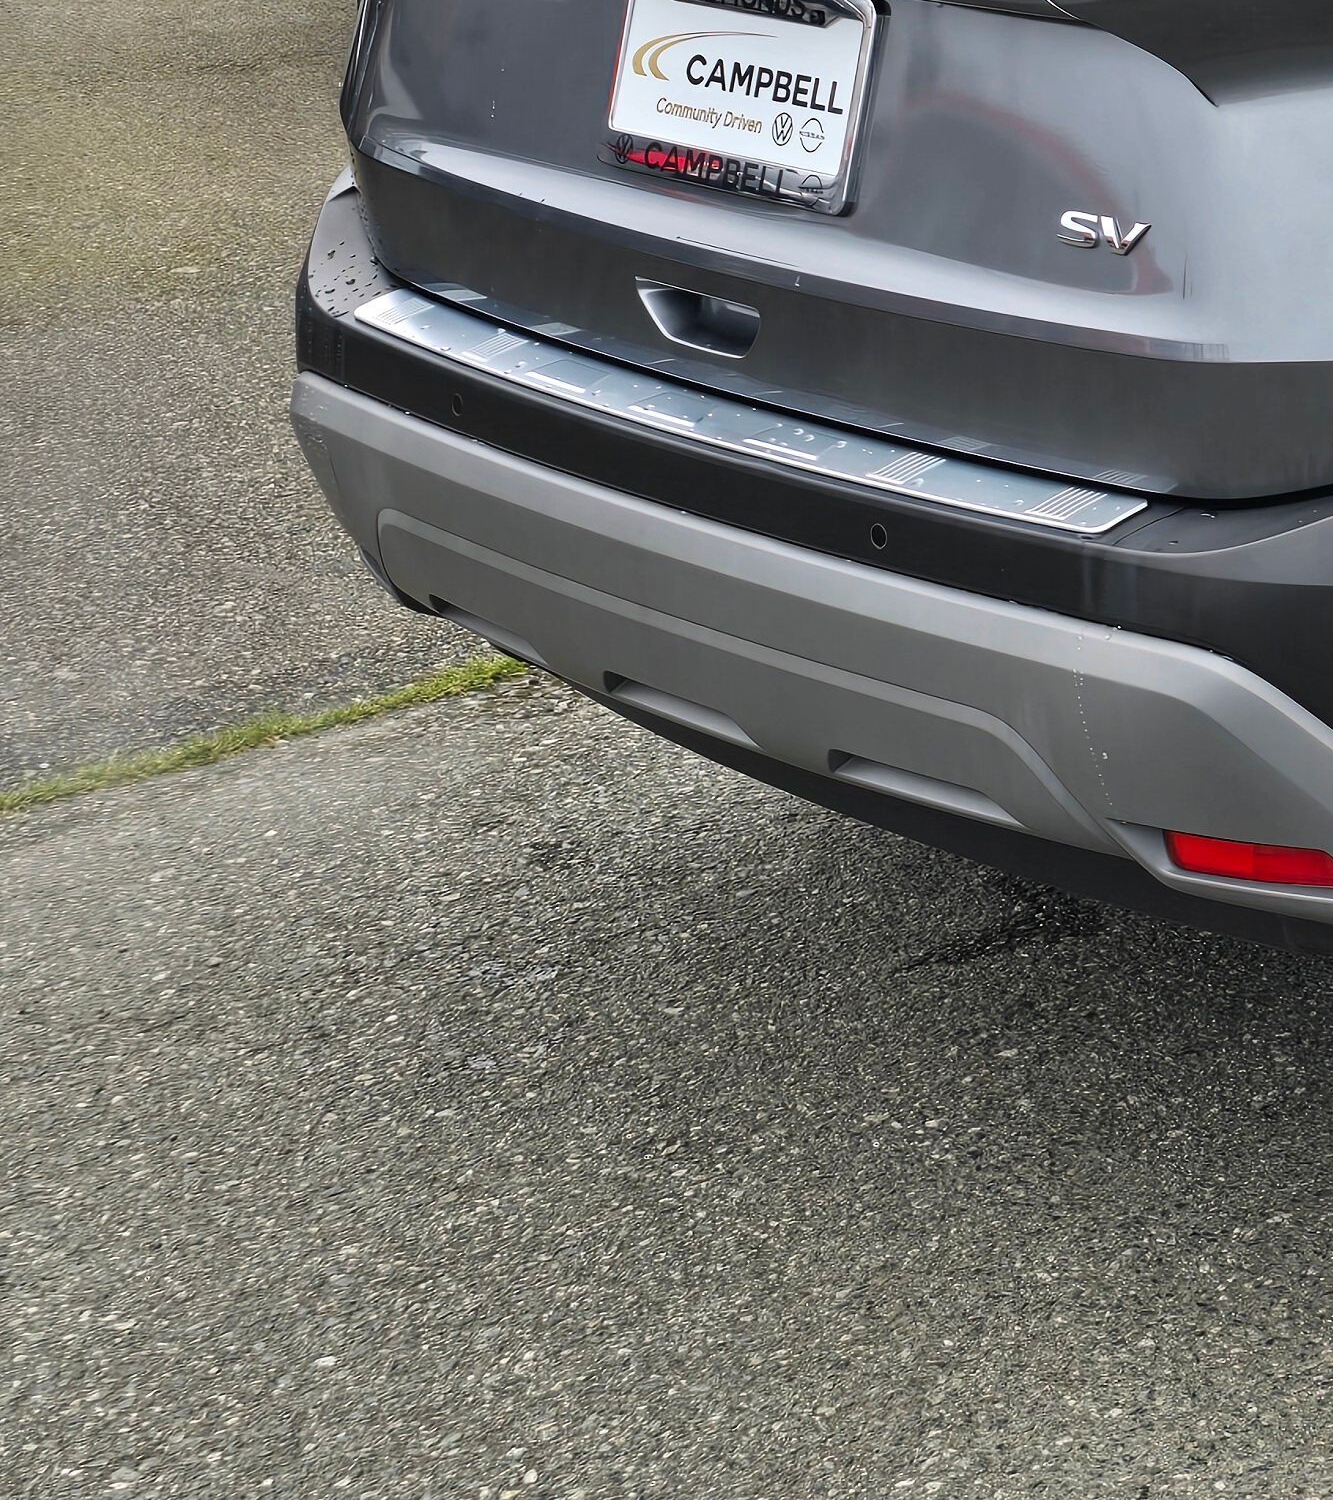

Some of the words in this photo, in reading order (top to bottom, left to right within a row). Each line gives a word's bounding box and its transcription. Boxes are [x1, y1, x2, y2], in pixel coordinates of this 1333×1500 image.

[686, 54, 843, 115] CAMPBELL
[656, 97, 722, 129] Community
[722, 111, 763, 134] Driven
[644, 141, 786, 199] CAMPBELL
[1056, 210, 1152, 256] SV
